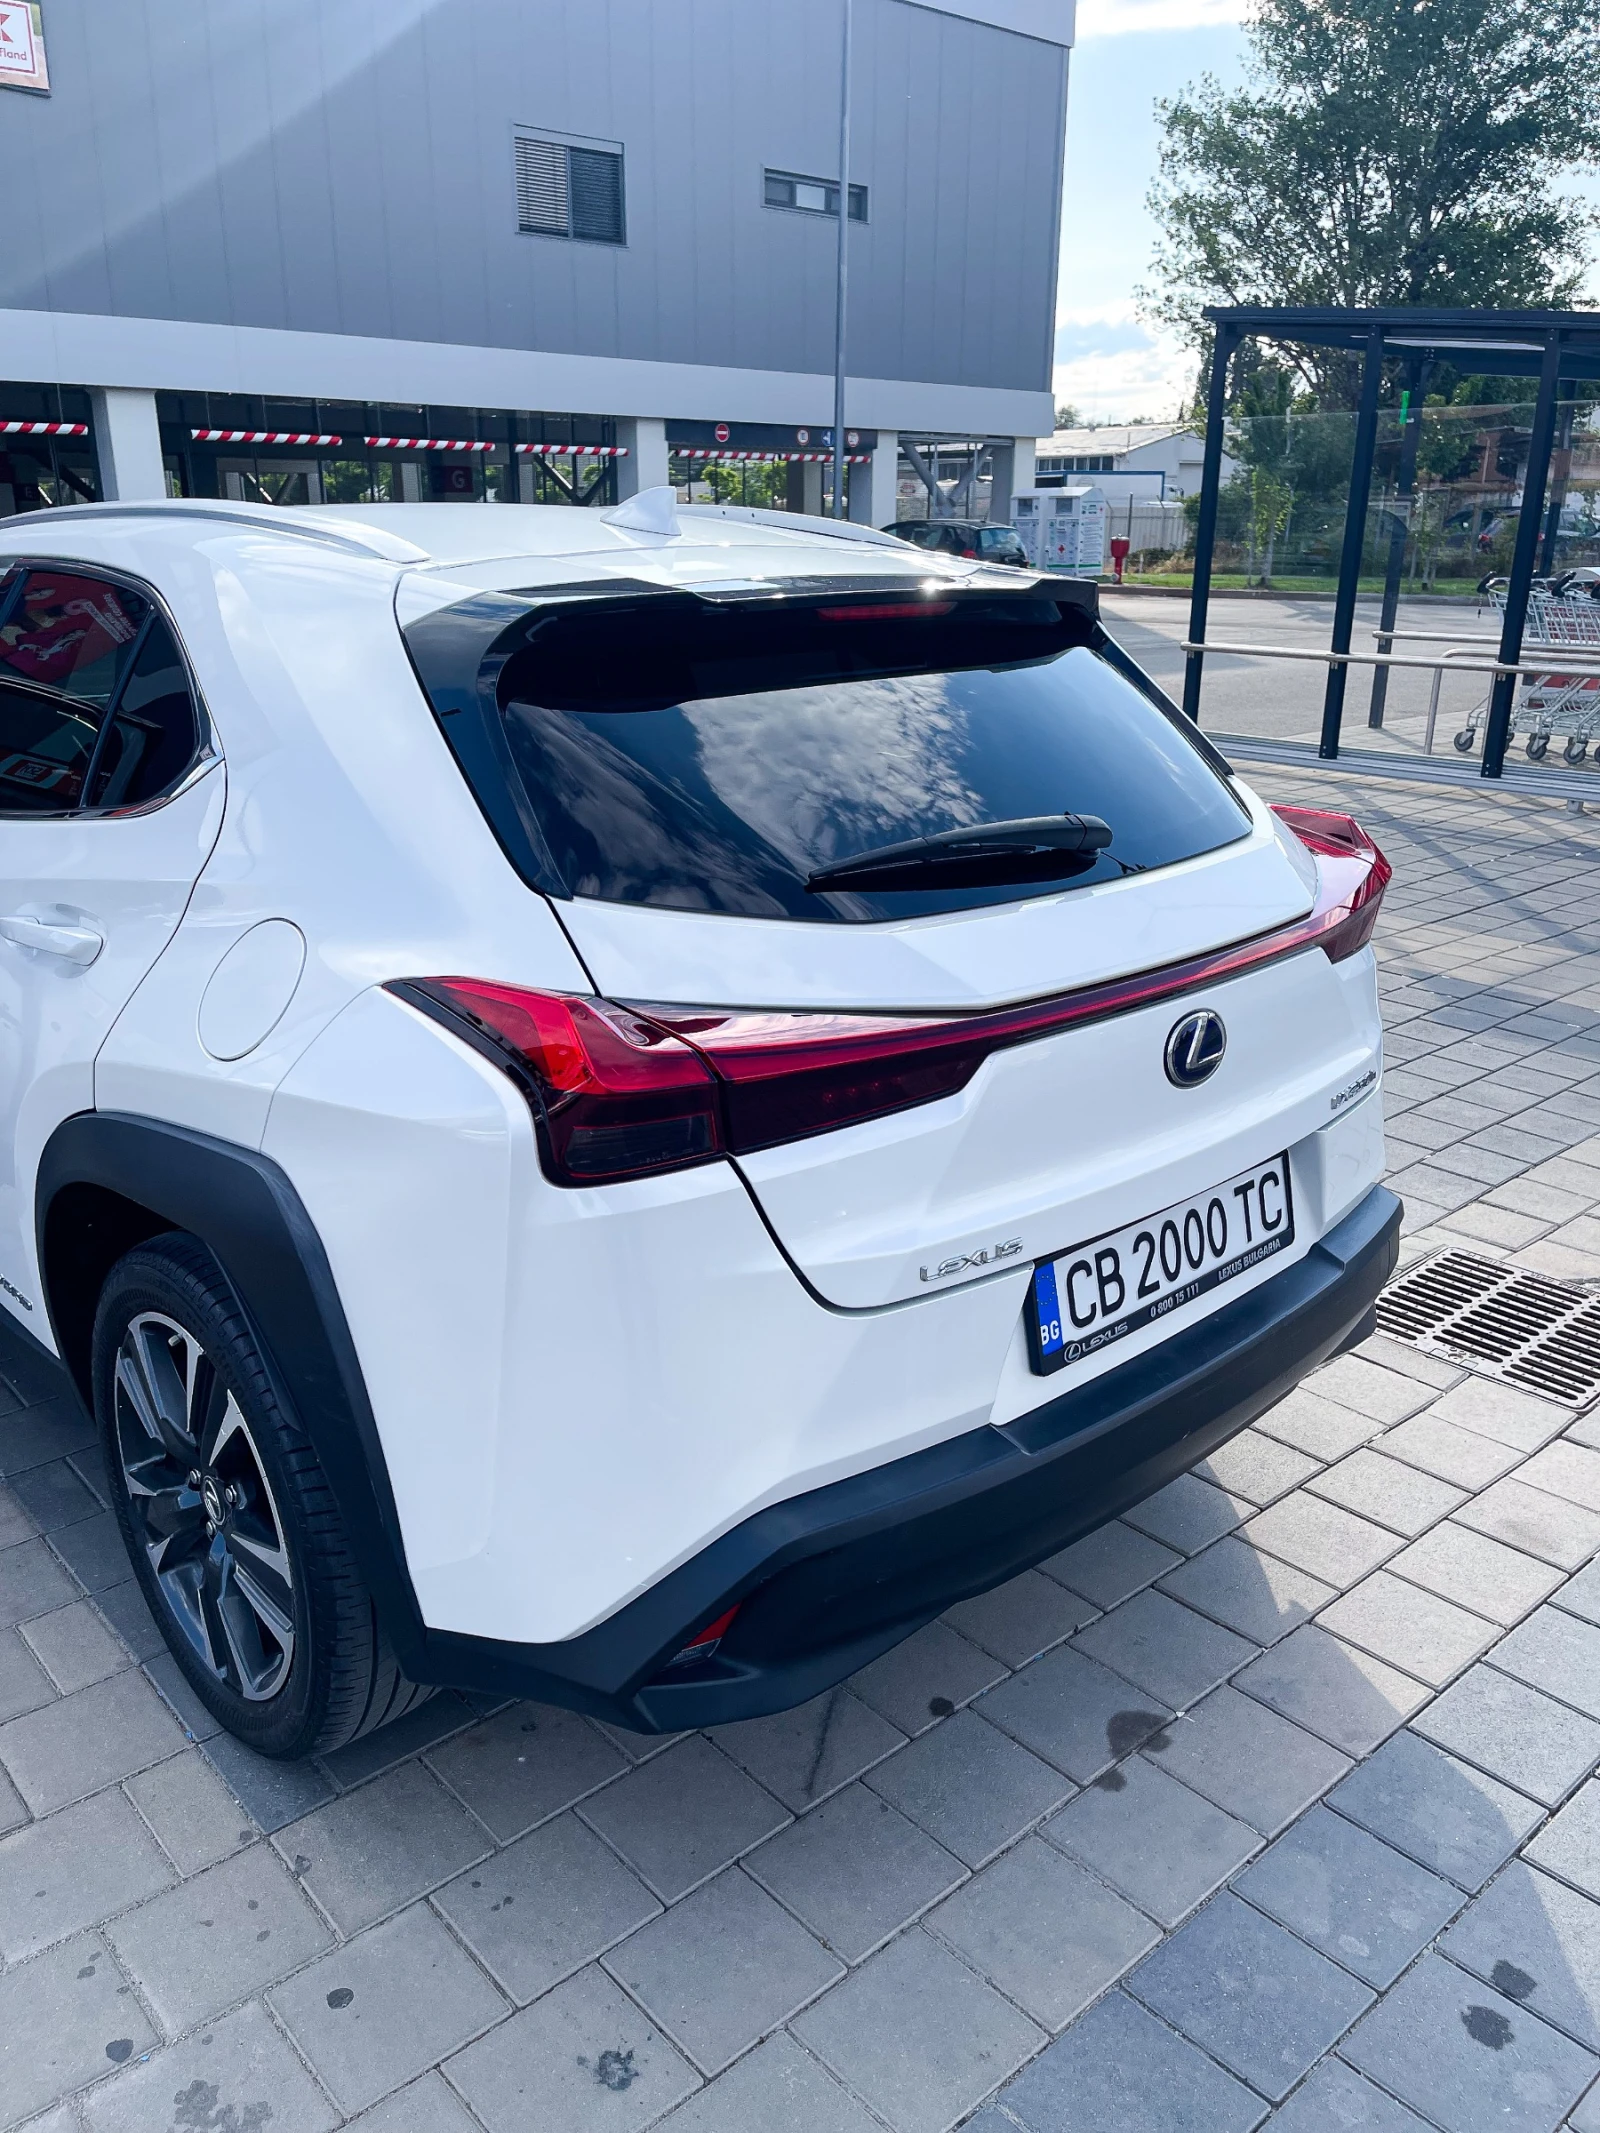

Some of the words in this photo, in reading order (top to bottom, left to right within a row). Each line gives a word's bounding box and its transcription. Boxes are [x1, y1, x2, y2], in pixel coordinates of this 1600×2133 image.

[919, 1236, 1024, 1282] LEXUS
[1067, 1247, 1125, 1329] CB
[1132, 1198, 1228, 1300] 2000
[1234, 1170, 1283, 1243] TC
[1218, 1259, 1243, 1281] LEXUS
[1243, 1238, 1281, 1267] BULGARIA
[1150, 1306, 1156, 1318] 0
[1157, 1297, 1174, 1315] 800
[1175, 1290, 1185, 1304] 15
[1040, 1320, 1060, 1345] BG
[1082, 1321, 1128, 1353] LEXUS
